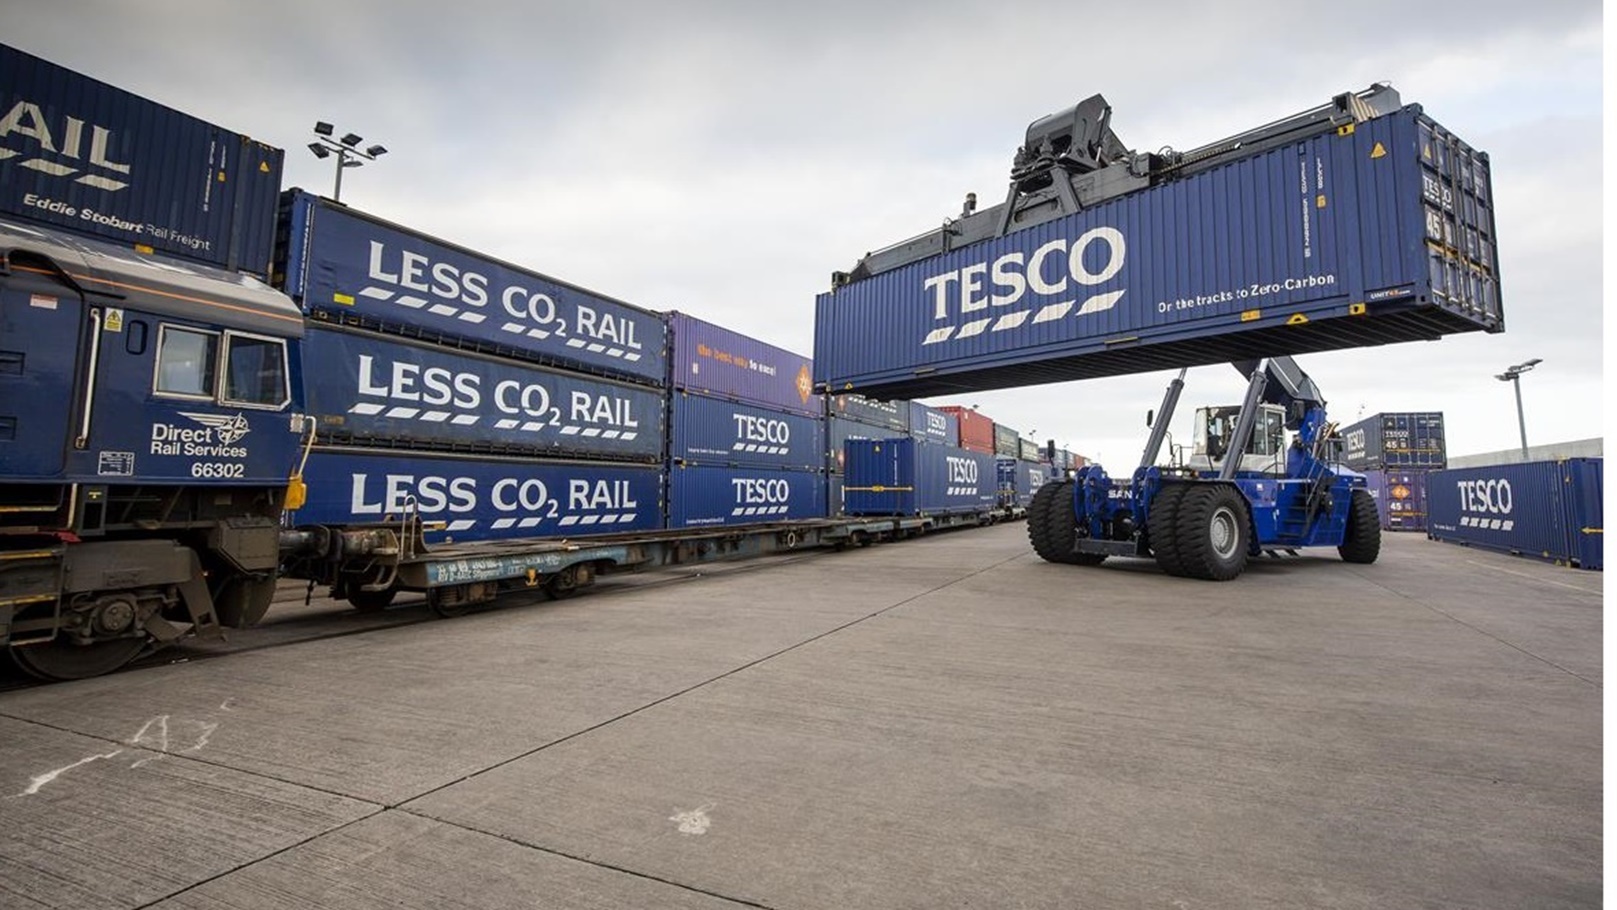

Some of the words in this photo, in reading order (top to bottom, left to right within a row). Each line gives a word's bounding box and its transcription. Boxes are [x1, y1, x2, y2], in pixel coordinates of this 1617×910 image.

[1422, 174, 1451, 203] TESO
[23, 193, 76, 217] Eddie
[80, 208, 144, 233] Stobart
[146, 223, 168, 240] Rail
[170, 230, 210, 251] Freight
[1426, 211, 1441, 239] 45
[924, 226, 1126, 320] TESCO
[369, 240, 488, 307] LESS
[576, 305, 642, 349] RAIL
[1175, 298, 1195, 310] the
[1196, 291, 1233, 306] tracks
[1236, 289, 1248, 299] to
[1250, 274, 1335, 297] Zero-Carbon
[358, 354, 480, 409] LESS
[570, 391, 638, 427] RAIL
[152, 423, 212, 443] Direct
[733, 413, 789, 444] TESCO
[927, 412, 946, 430] TESCO
[151, 442, 180, 455] Rail
[184, 443, 247, 457] Services
[1386, 440, 1397, 449] 45
[191, 463, 244, 477] 66302
[946, 456, 977, 483] TESCO
[351, 473, 477, 514] LESS
[568, 479, 637, 510] RAIL
[732, 478, 789, 503] TESCO
[1457, 478, 1513, 515] TESCO
[1391, 502, 1402, 511] 45
